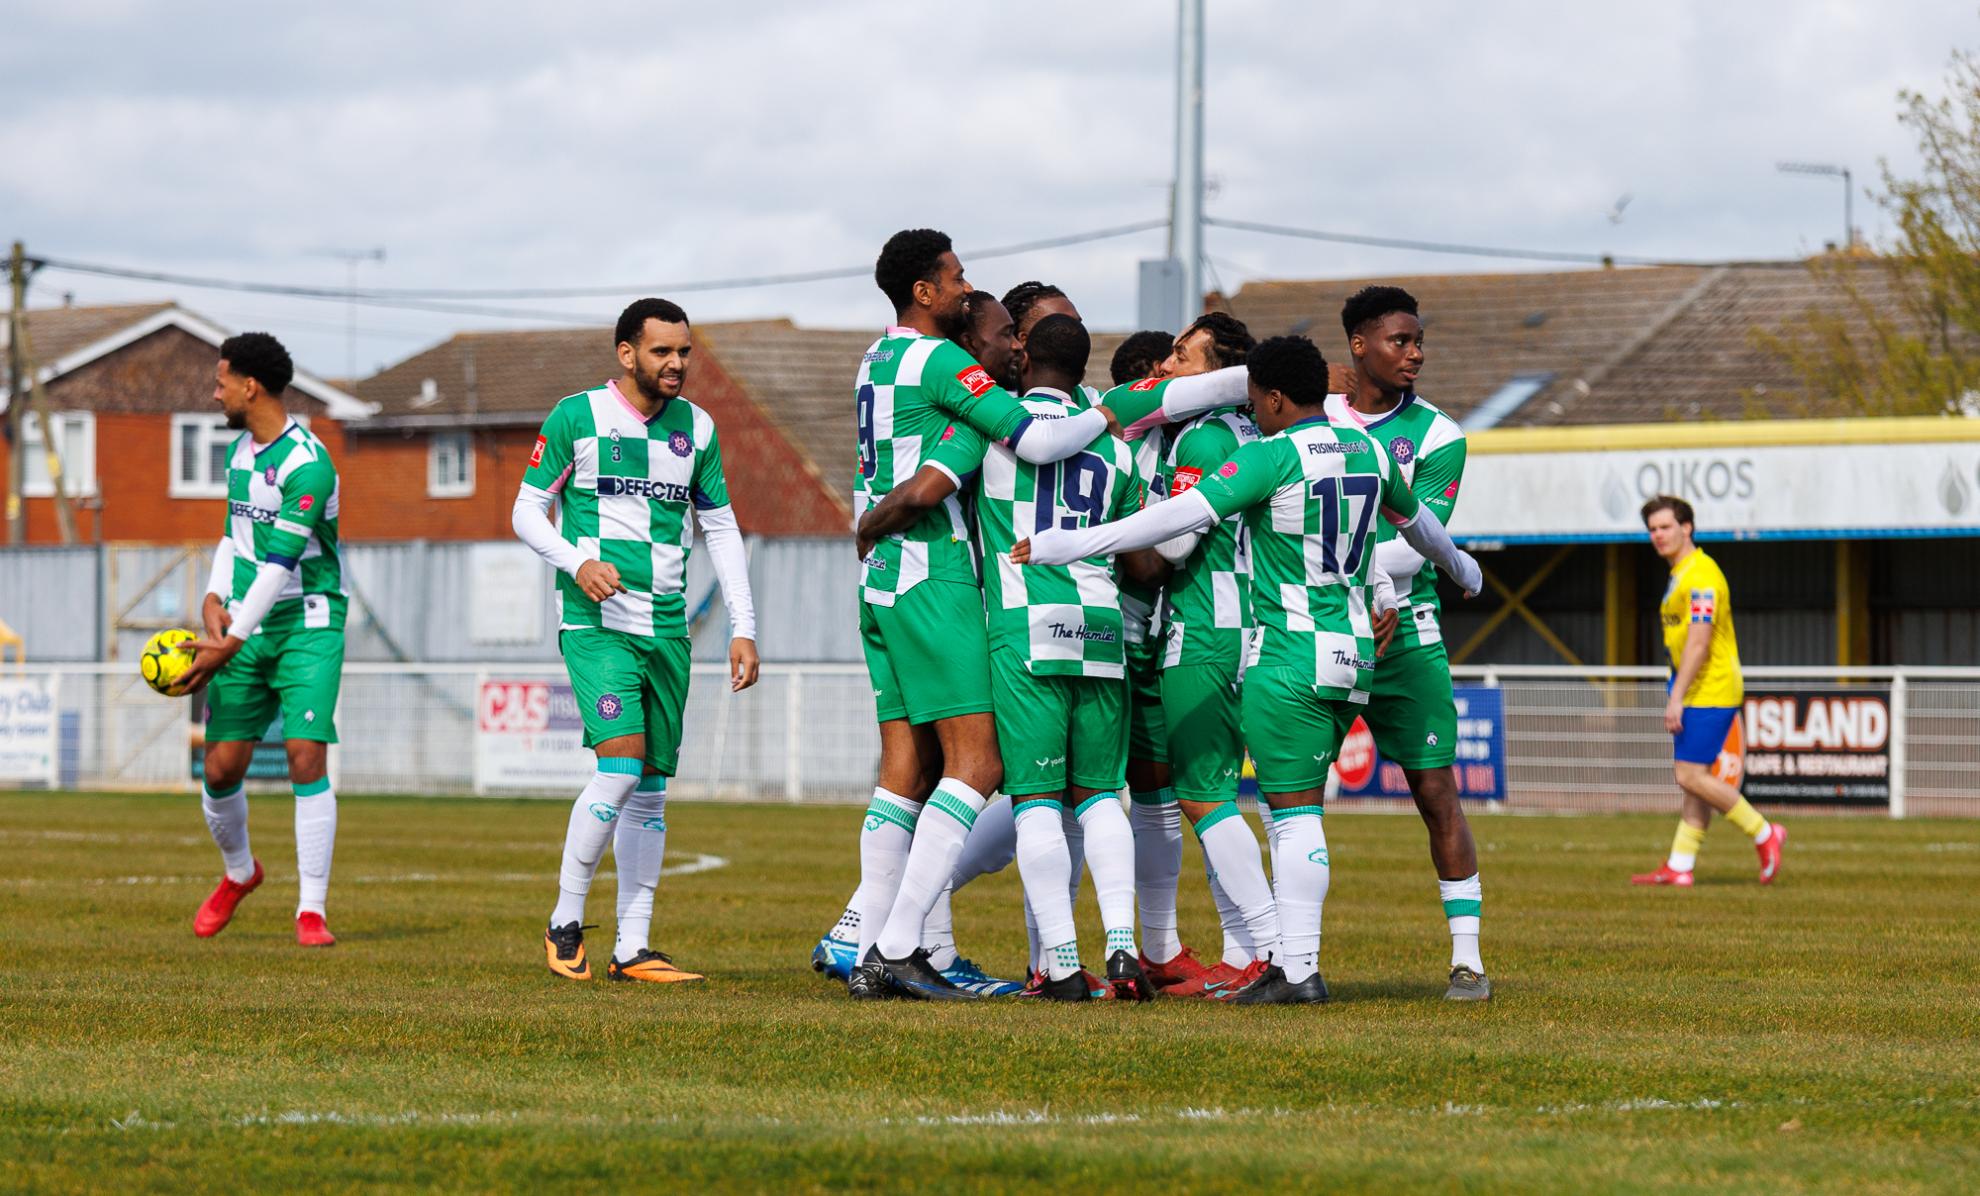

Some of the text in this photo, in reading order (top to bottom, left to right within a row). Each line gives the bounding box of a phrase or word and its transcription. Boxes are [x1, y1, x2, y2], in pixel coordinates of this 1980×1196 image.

[612, 446, 621, 462] 3
[857, 384, 877, 480] 9
[1035, 450, 1109, 536] 19
[1636, 459, 1755, 501] OIKOS
[1312, 475, 1379, 575] 17
[1048, 622, 1116, 641] The Hamlet
[1332, 649, 1377, 670] The Hamle
[1744, 698, 1888, 749] ISLAND
